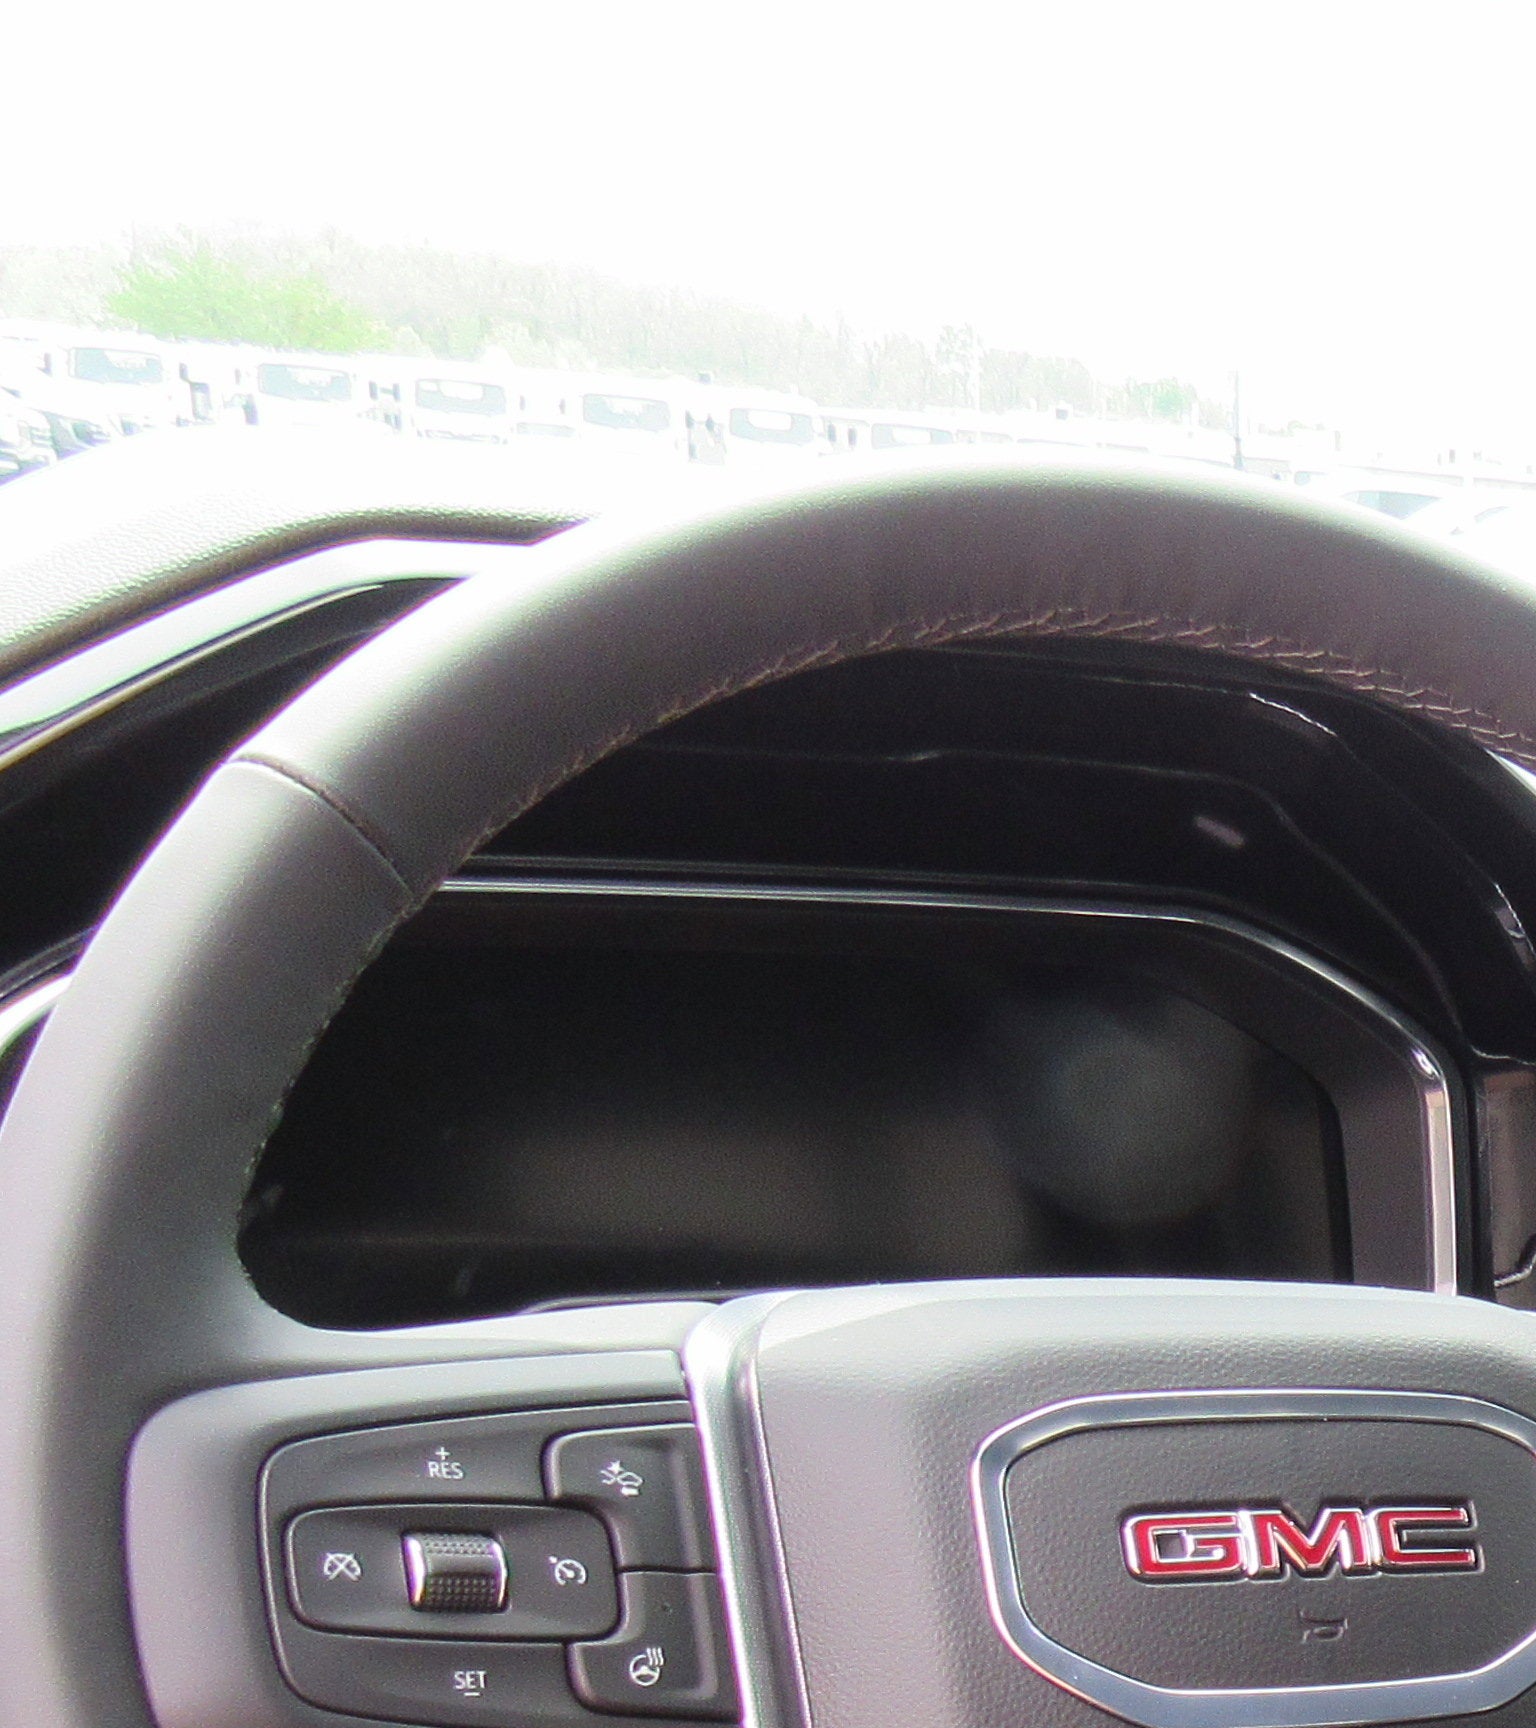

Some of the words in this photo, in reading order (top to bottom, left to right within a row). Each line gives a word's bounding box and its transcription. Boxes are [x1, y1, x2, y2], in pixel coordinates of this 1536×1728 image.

[427, 1461, 463, 1480] RES
[1125, 1506, 1476, 1576] GMC
[454, 1670, 486, 1690] SET
